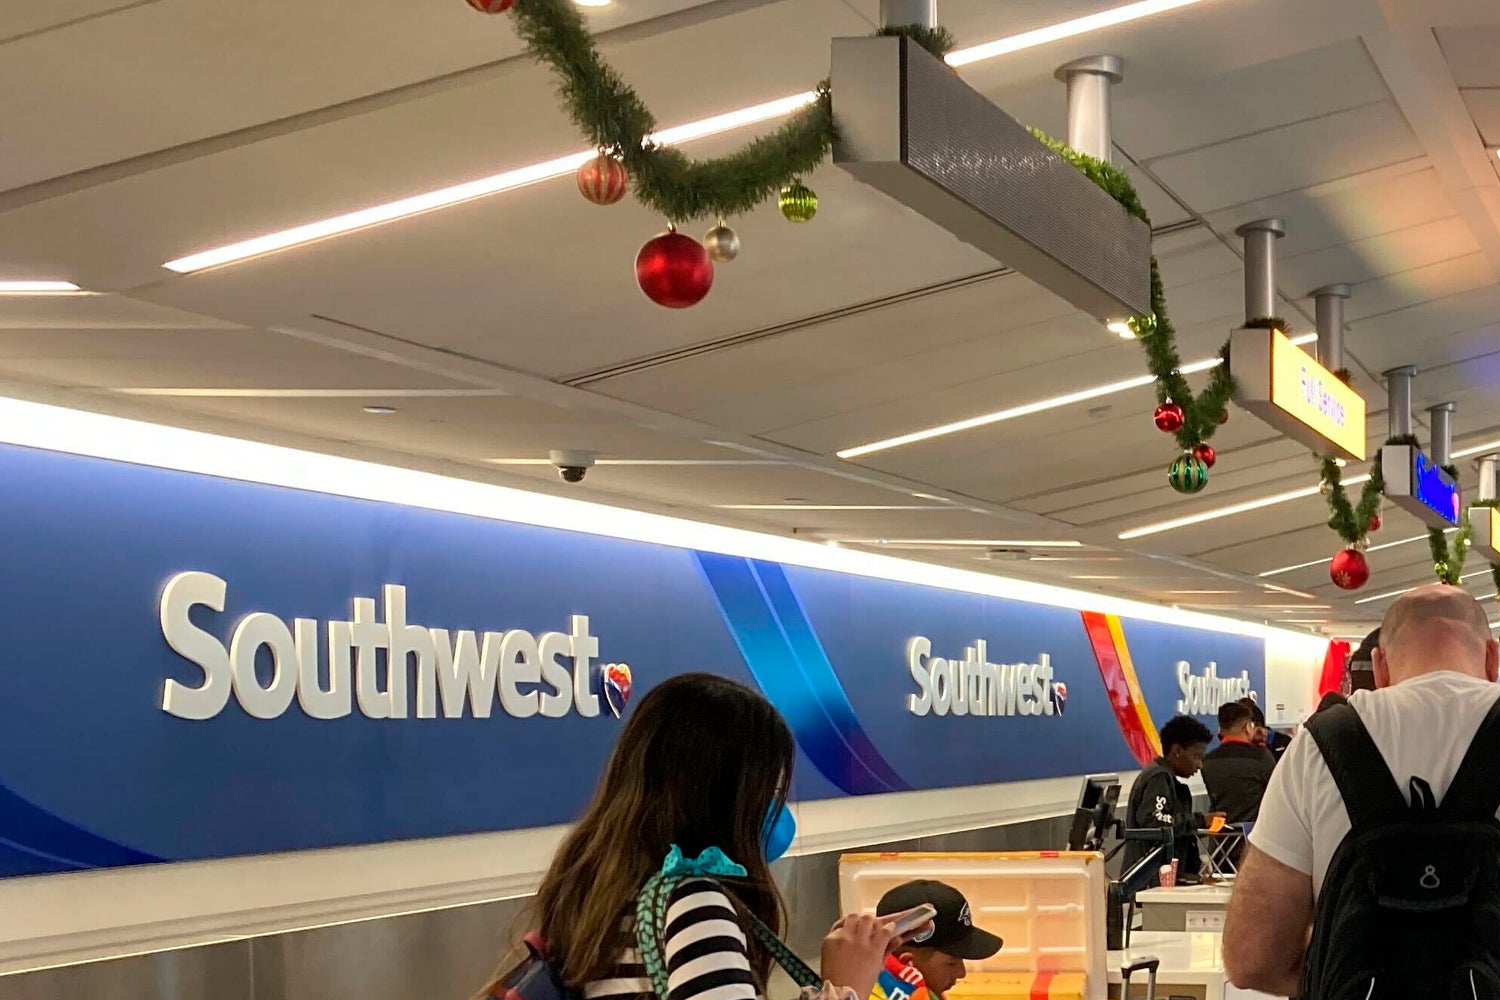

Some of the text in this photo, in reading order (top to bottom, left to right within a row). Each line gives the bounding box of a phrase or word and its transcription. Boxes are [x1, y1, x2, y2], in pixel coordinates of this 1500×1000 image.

[160, 570, 600, 720] Southwest
[909, 636, 1054, 716] Southwest
[899, 965, 924, 985] m
